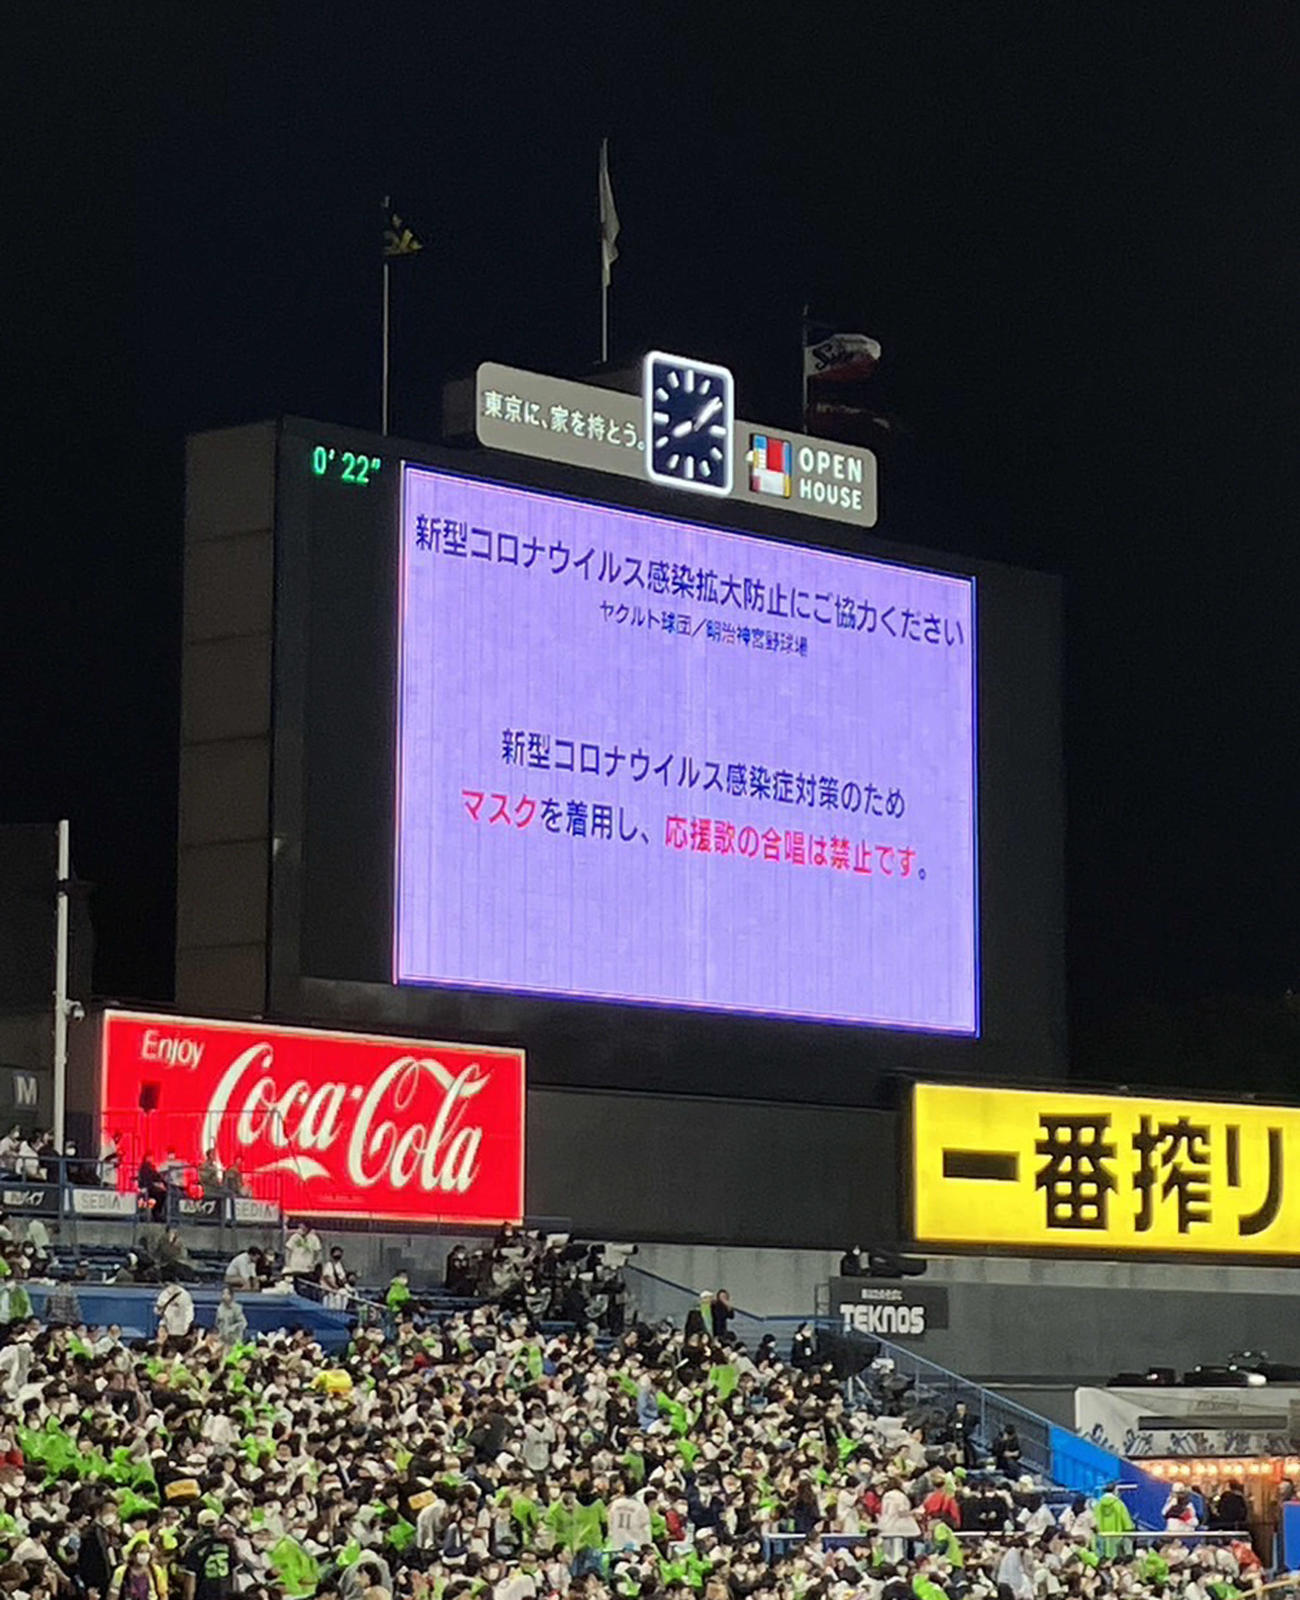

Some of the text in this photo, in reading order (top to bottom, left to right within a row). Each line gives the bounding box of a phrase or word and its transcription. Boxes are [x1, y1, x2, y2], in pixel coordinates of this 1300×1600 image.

[484, 391, 645, 451] 東京に、家を持とう。
[799, 447, 863, 483] OPEN
[800, 480, 863, 511] HOUSE
[415, 512, 965, 647] 新型コロナウイルス感染拡大防止にご協力ください
[501, 727, 906, 818] 新型コロナウイルス感染症対策のため
[140, 1030, 204, 1070] Enjoy
[202, 1042, 494, 1194] Coca-Cola
[840, 1303, 925, 1334] TEKNOS
